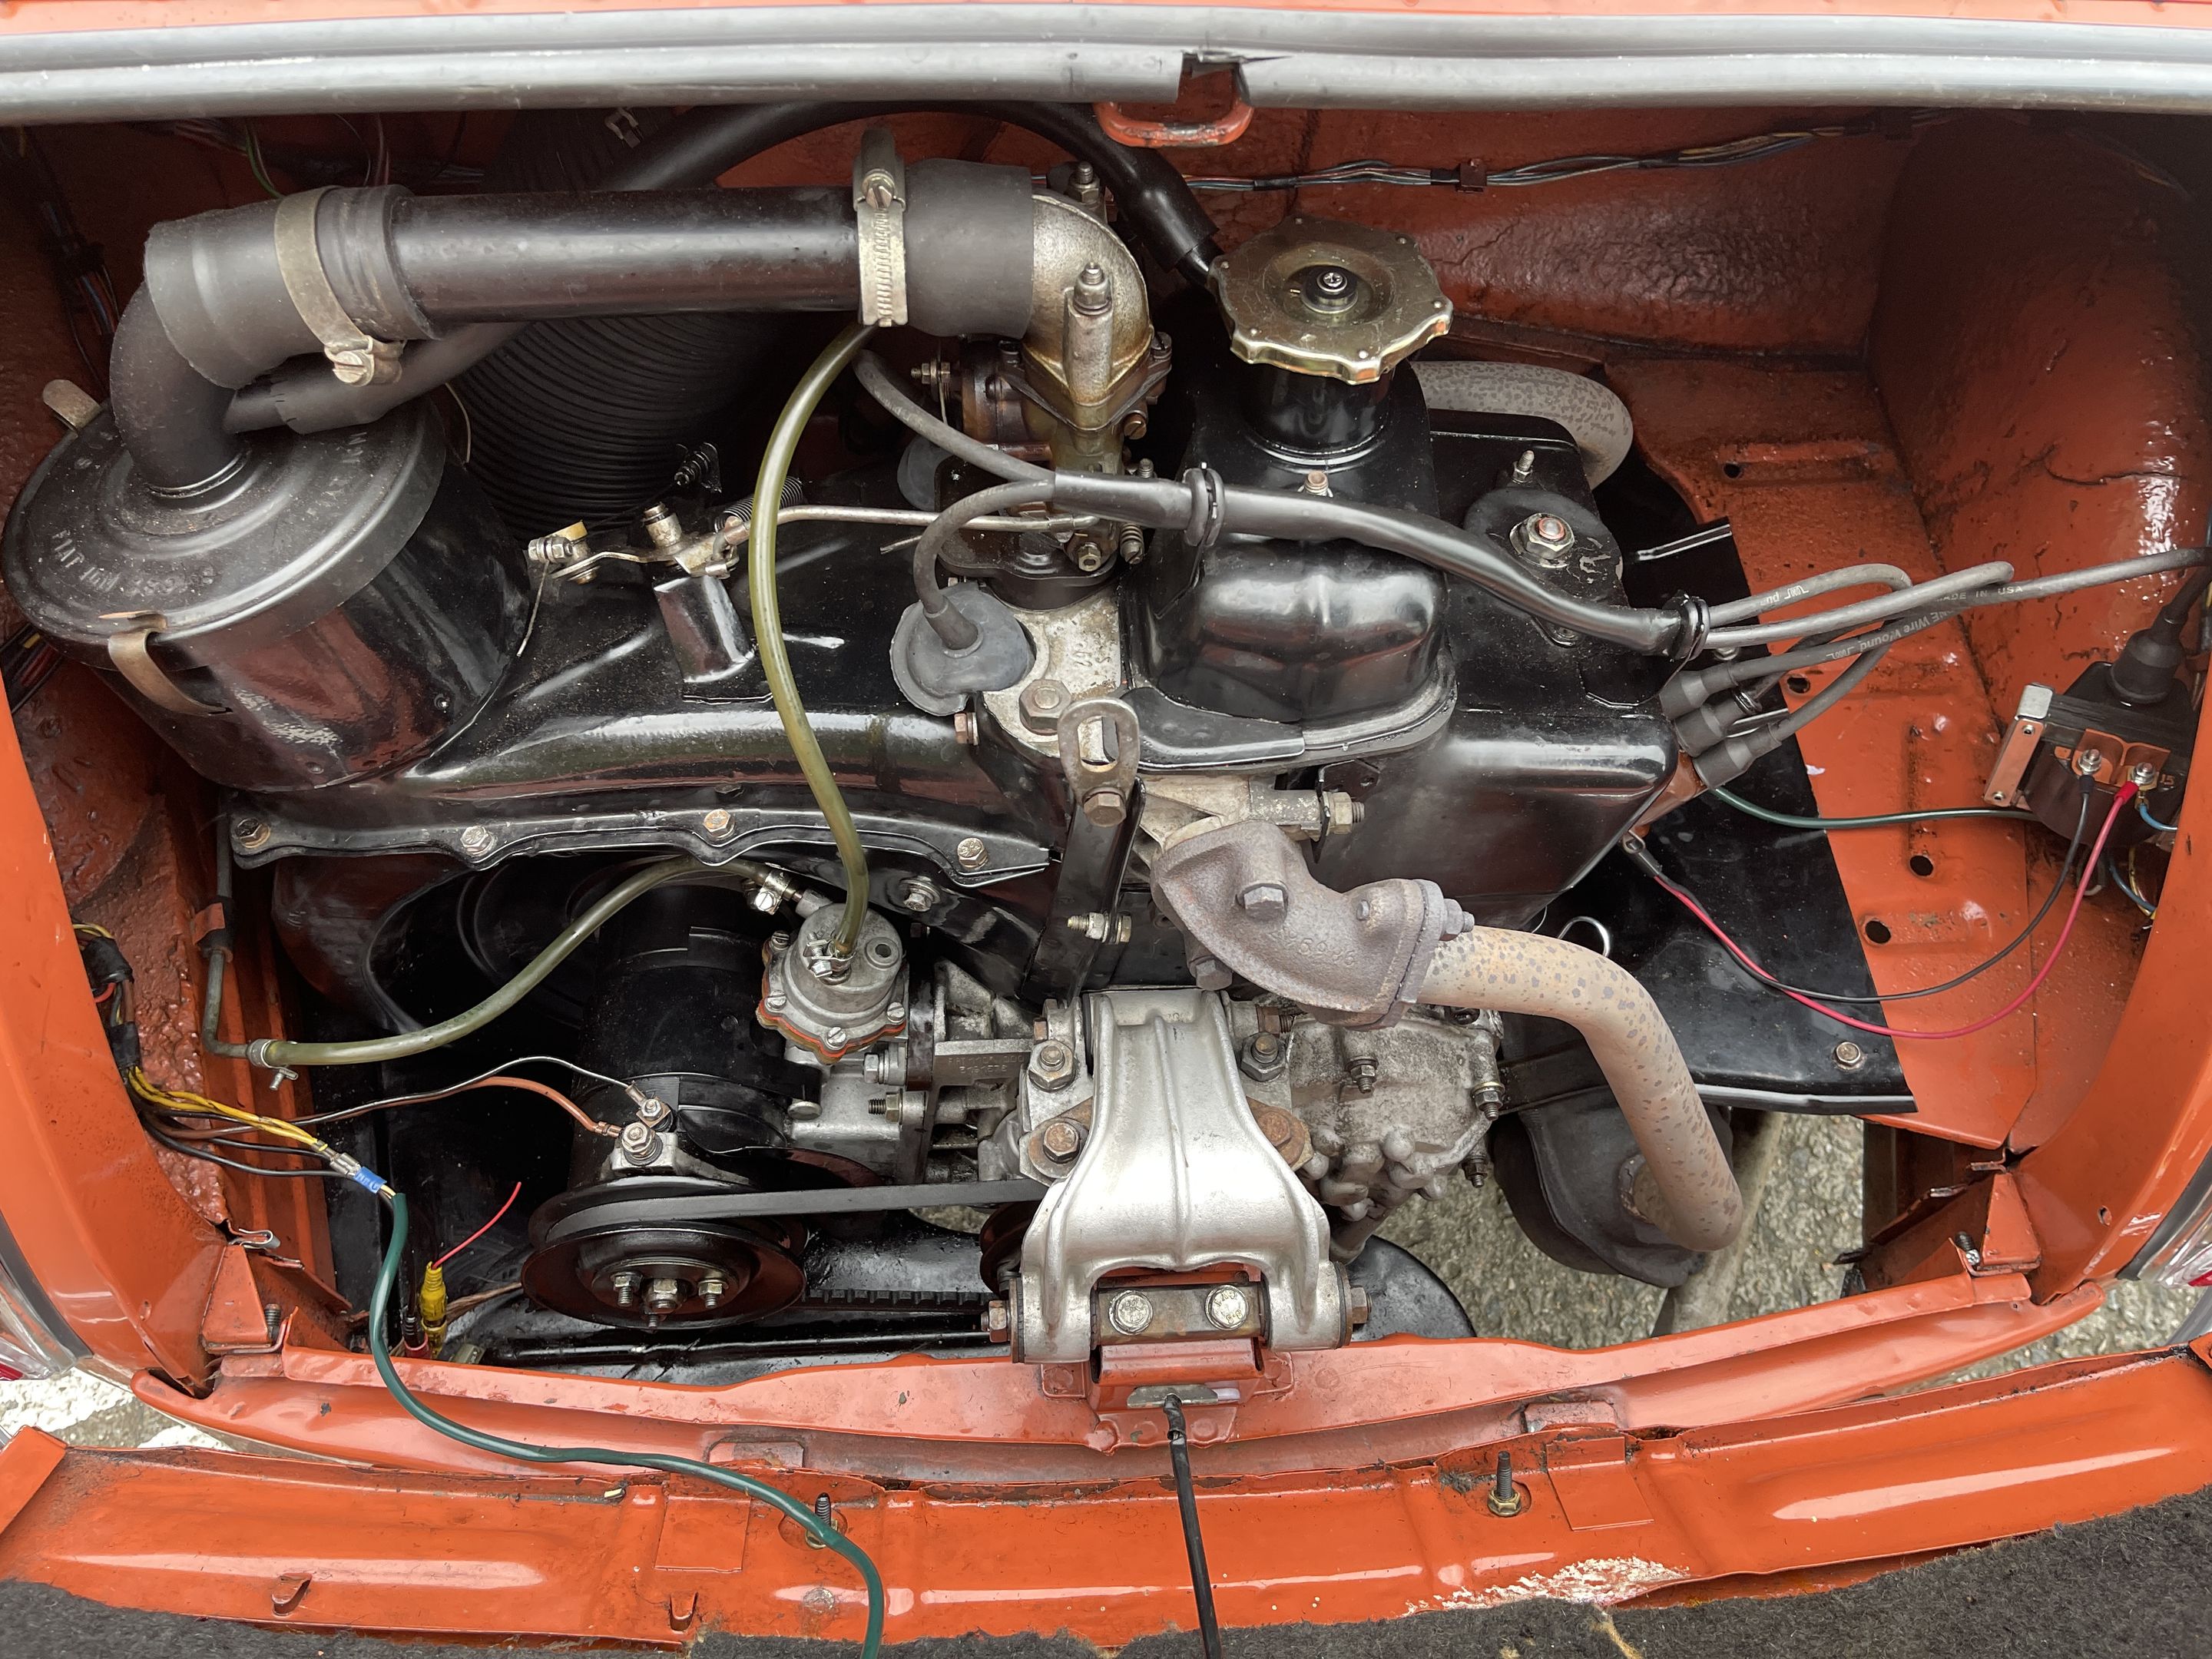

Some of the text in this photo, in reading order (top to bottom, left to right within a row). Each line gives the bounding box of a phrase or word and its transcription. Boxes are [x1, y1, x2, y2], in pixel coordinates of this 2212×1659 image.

[1936, 591, 1967, 602] ADE
[1998, 585, 2024, 595] USA
[1903, 616, 1930, 633] Wire
[1859, 629, 1902, 652] Wound
